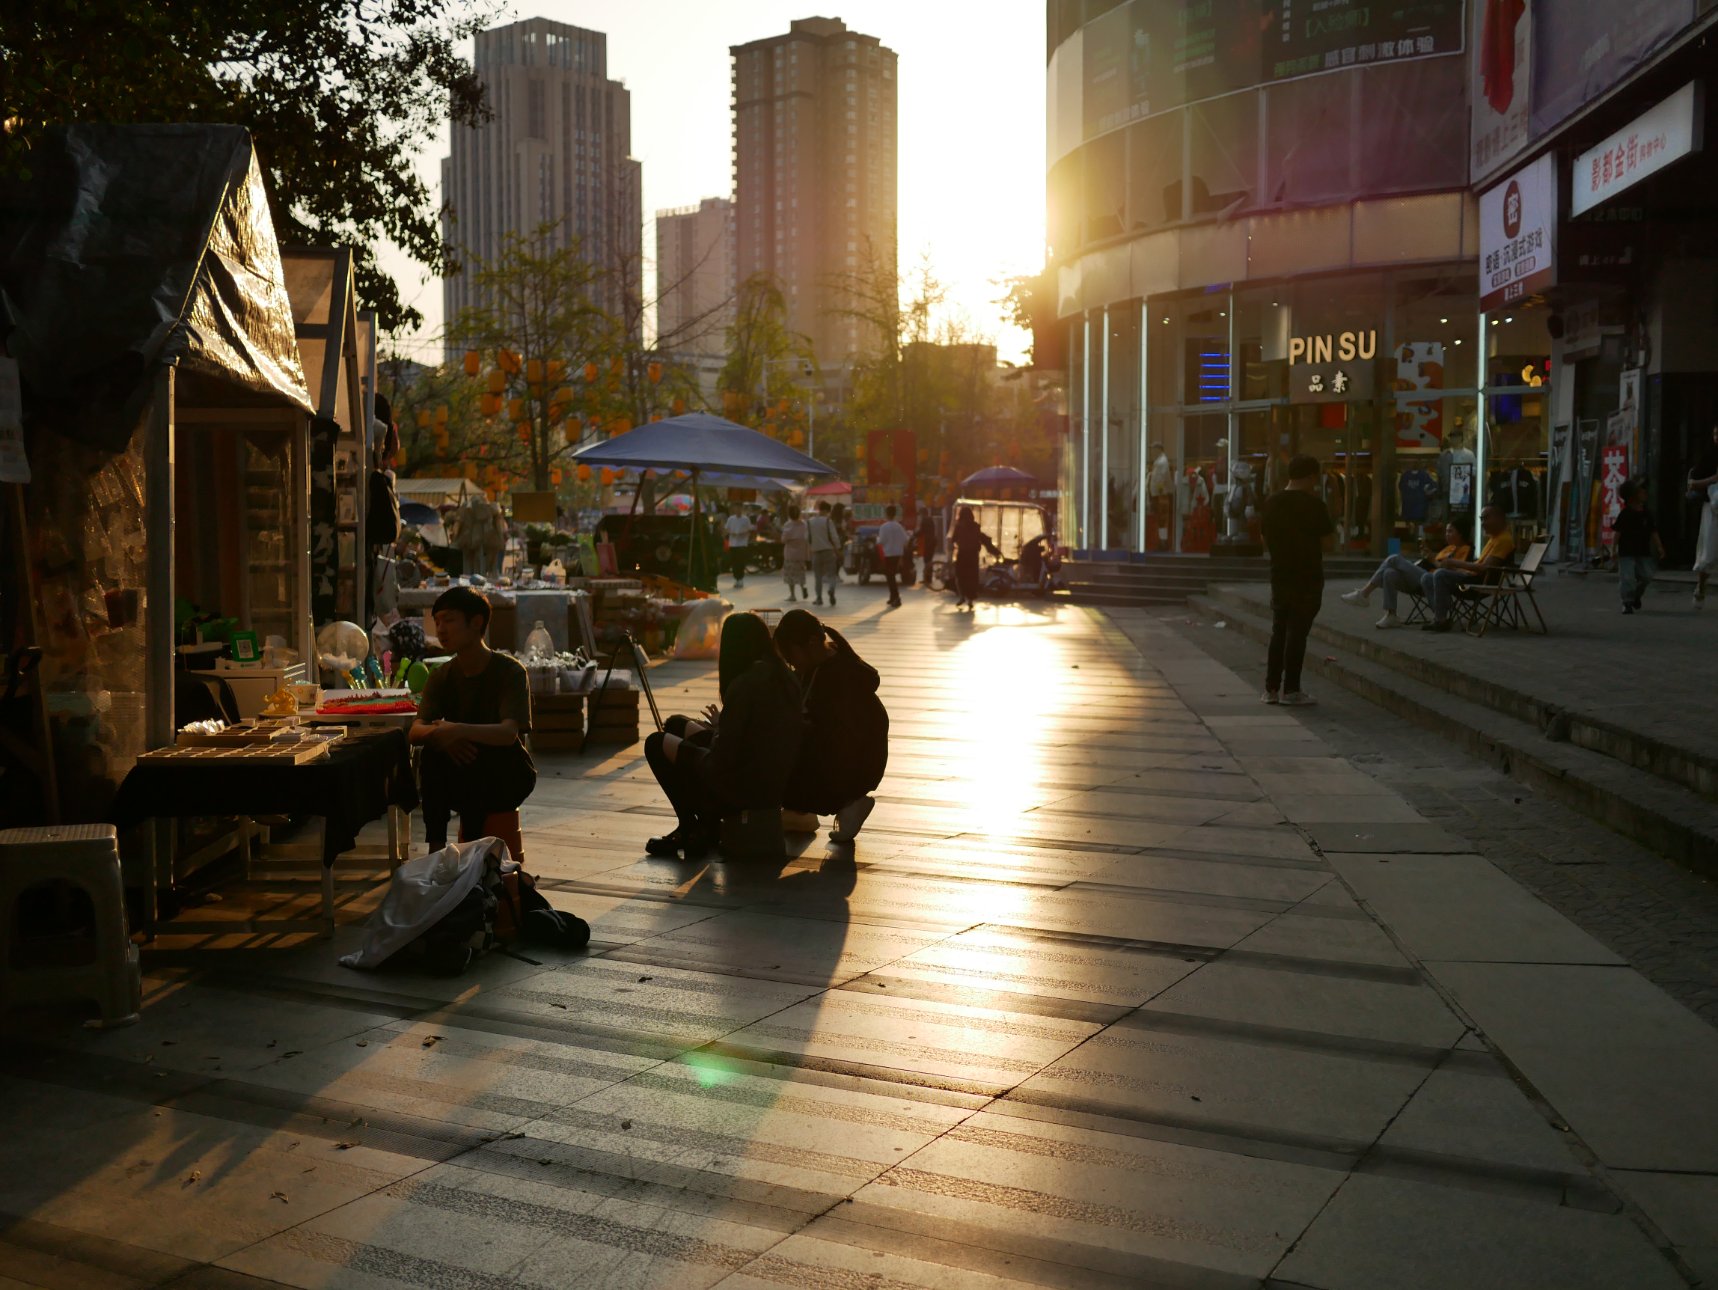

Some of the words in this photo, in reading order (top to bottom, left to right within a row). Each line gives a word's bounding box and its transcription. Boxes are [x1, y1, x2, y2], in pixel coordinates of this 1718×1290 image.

[1507, 193, 1519, 225] 密
[1289, 334, 1333, 366] PIN
[1338, 330, 1376, 361] SU
[1308, 369, 1348, 393] 品素
